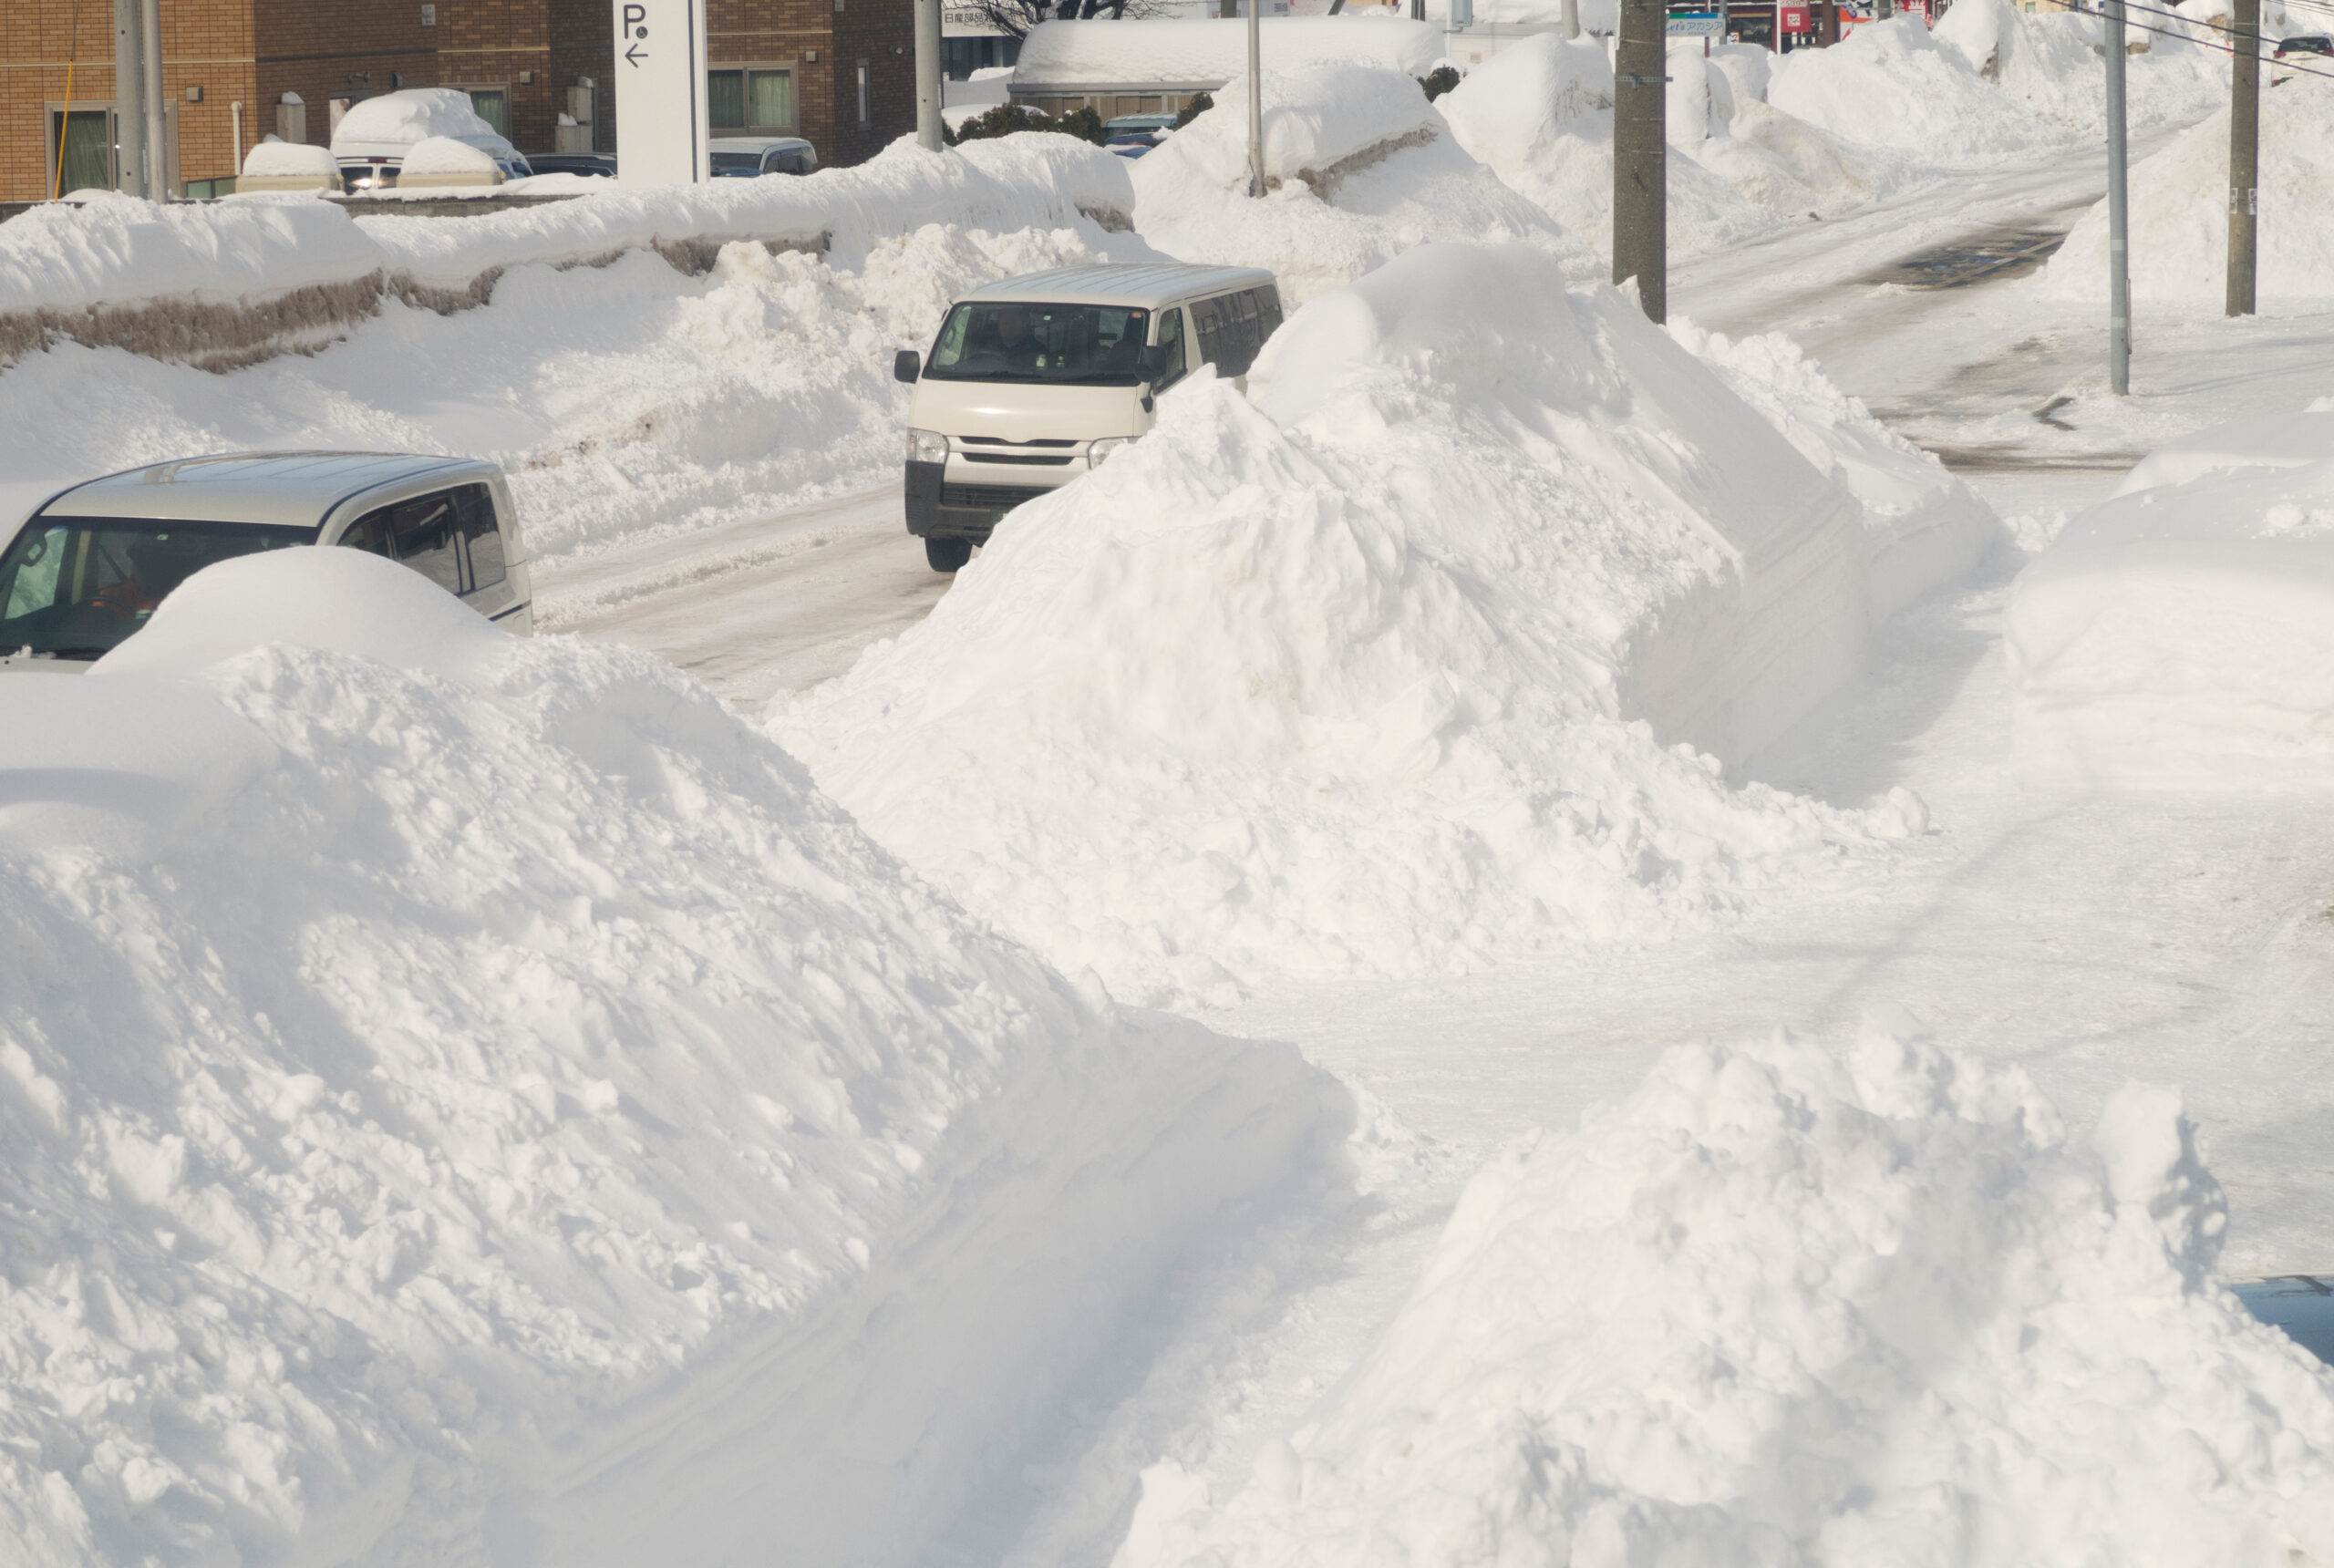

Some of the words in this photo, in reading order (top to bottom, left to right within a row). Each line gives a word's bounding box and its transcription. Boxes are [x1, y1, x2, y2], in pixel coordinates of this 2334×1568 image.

[624, 5, 645, 39] P
[1687, 21, 1723, 31] アカシア
